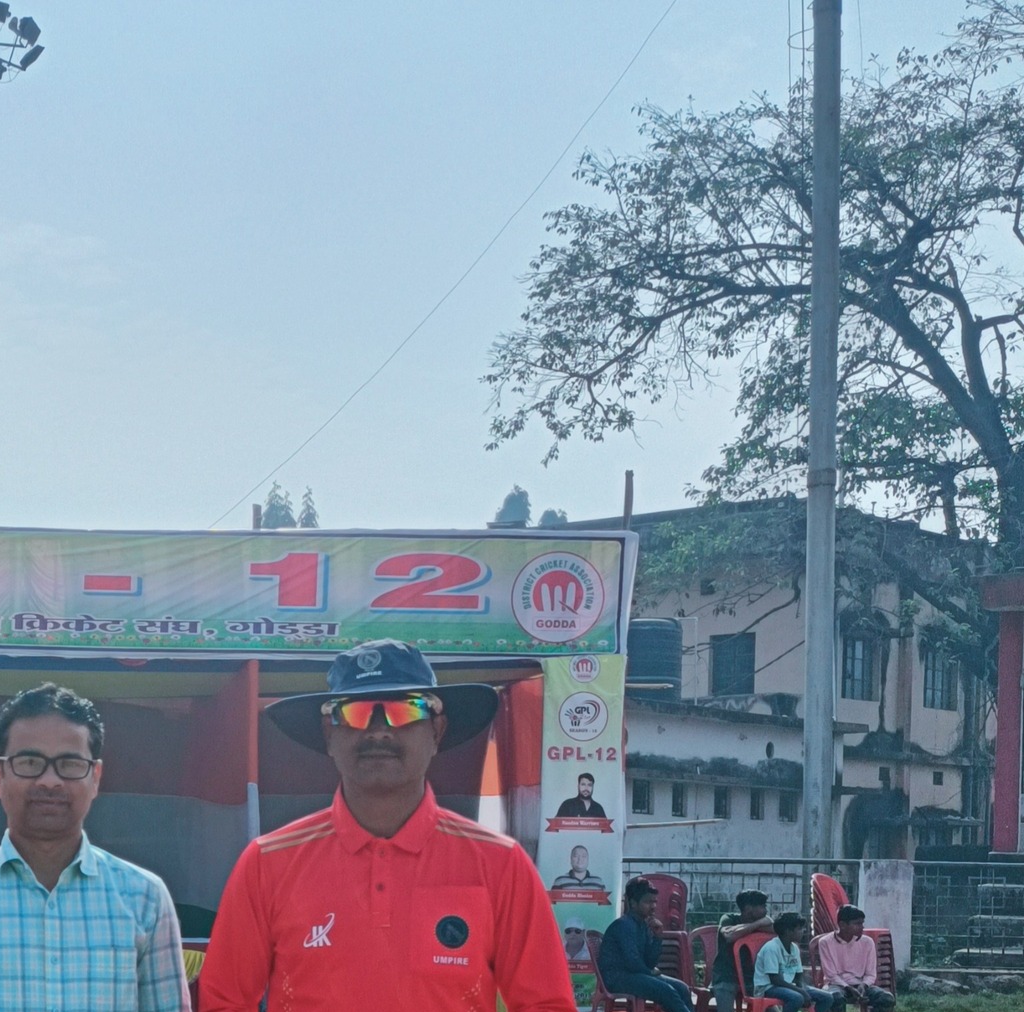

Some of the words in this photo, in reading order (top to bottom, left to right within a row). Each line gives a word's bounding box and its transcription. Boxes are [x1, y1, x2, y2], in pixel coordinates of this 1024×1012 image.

[249, 551, 491, 614] 12
[522, 573, 536, 610] DISTRICT
[535, 560, 568, 575] CRICKET
[569, 562, 594, 610] ASSOCIATION
[10, 613, 125, 634] क्रिकेट
[536, 619, 576, 629] GODDA
[356, 671, 382, 679] UMPIRE
[574, 706, 590, 715] GPL
[547, 746, 617, 762] GPL-12
[433, 956, 469, 966] UMPIRE
